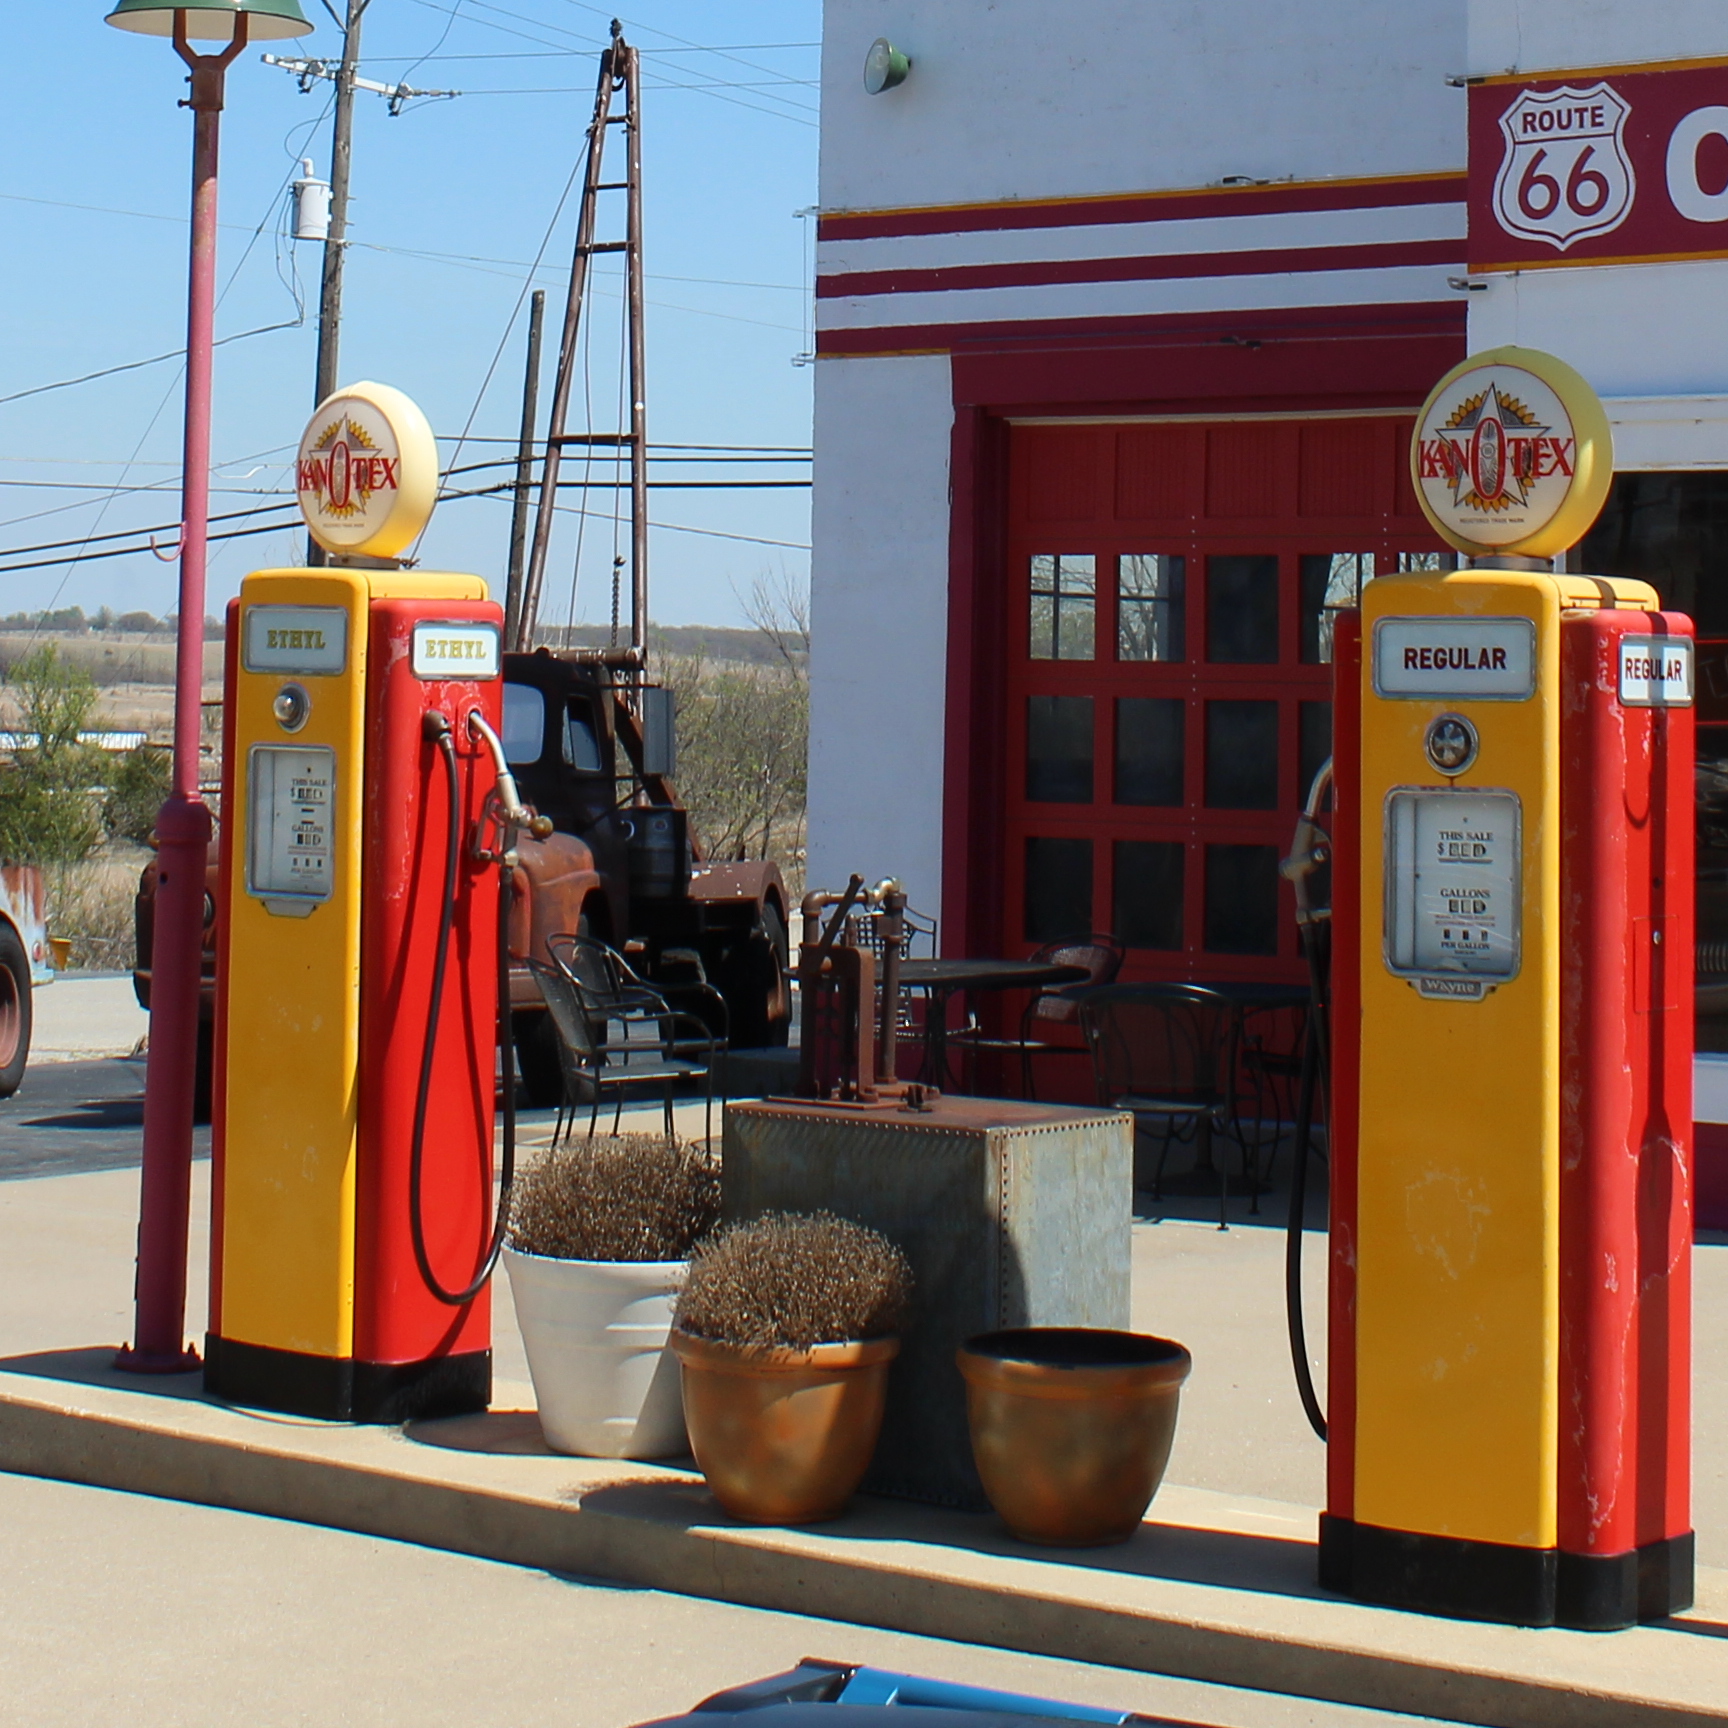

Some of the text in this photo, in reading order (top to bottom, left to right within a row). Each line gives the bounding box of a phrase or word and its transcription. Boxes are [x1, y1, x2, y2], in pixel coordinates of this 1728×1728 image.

[1521, 104, 1606, 135] ROUTE
[1517, 144, 1611, 221] 66
[267, 629, 327, 649] ETHYL
[425, 639, 487, 659] ETHYL
[1403, 647, 1507, 670] REGULAR
[1624, 657, 1683, 682] REGULAR
[1438, 830, 1494, 842] THIS SALE
[1440, 888, 1491, 899] GALLONS
[1425, 979, 1476, 993] Wayne
